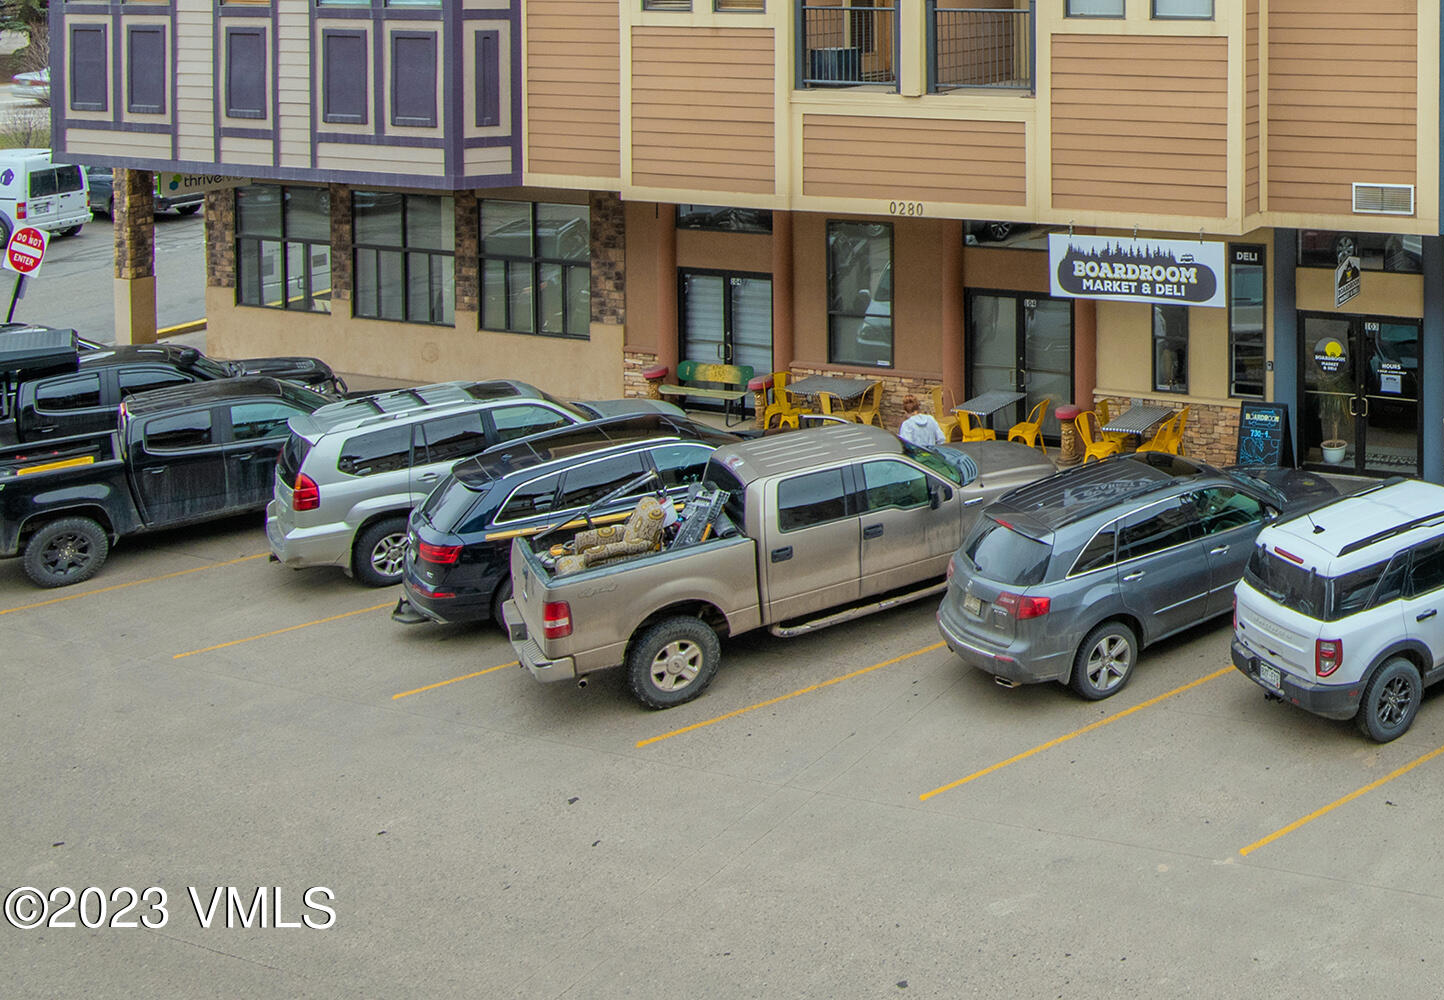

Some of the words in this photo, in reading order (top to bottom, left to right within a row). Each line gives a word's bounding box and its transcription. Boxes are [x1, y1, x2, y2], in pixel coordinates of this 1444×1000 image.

[890, 201, 923, 216] 0280
[17, 232, 28, 242] DO
[28, 237, 42, 248] NOT
[13, 253, 35, 266] ENTER
[1236, 251, 1258, 262] DELI
[1072, 260, 1198, 284] BOARDROOM
[1082, 278, 1137, 294] MARKET
[1141, 281, 1151, 294] &
[1155, 283, 1185, 297] DELI
